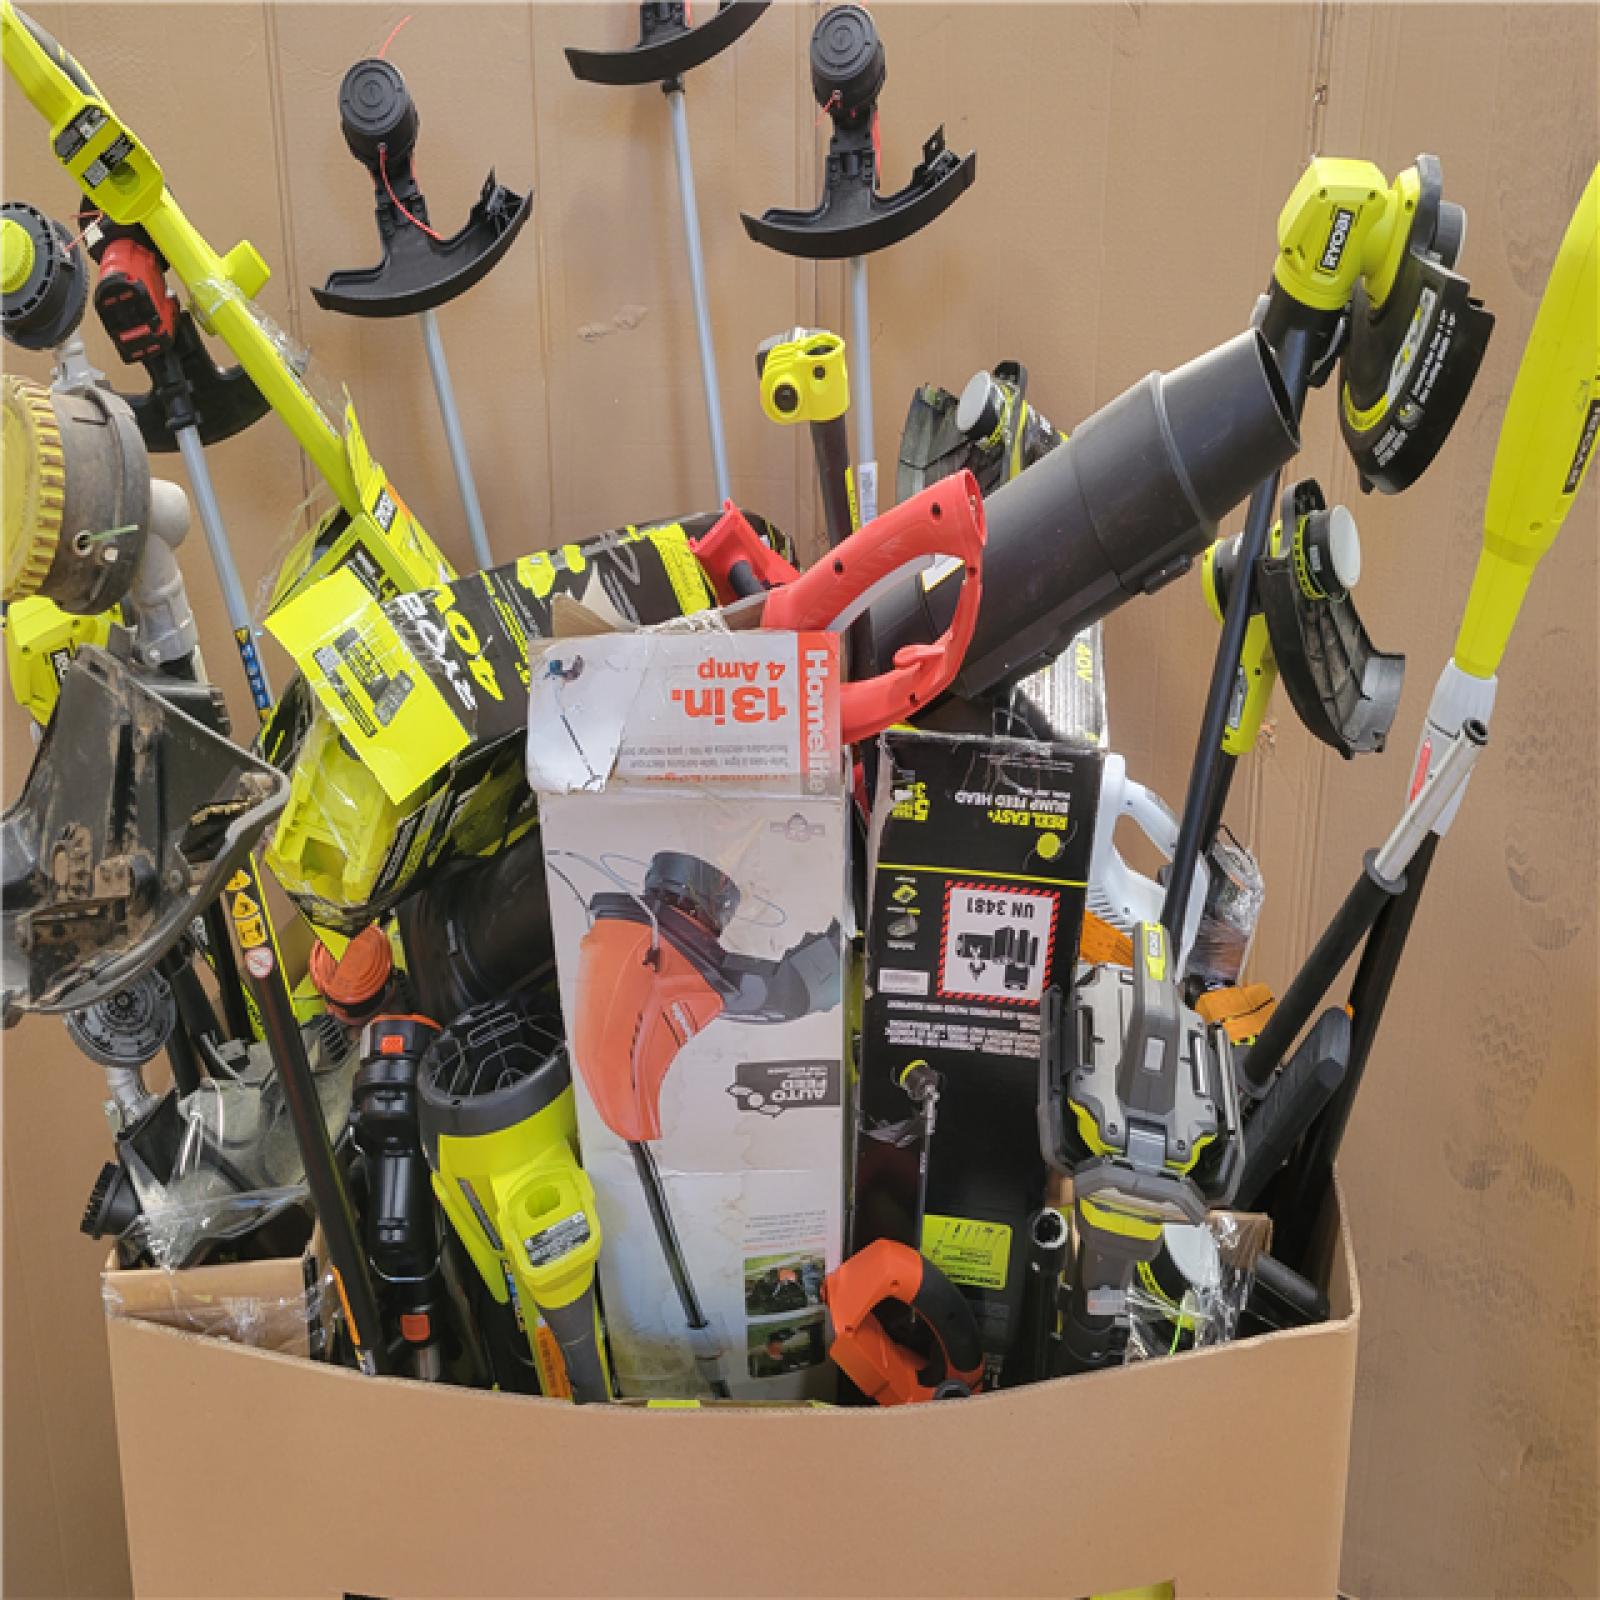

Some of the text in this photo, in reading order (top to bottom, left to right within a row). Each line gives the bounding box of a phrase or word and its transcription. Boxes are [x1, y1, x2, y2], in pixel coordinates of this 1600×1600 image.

[1322, 211, 1351, 267] RYOBI
[395, 592, 479, 712] RYOB
[697, 657, 786, 682] 4 Amp
[671, 685, 788, 727] 13 in.
[806, 649, 832, 793] Homelite
[913, 799, 931, 821] 5
[966, 896, 1036, 919] UN 3481
[770, 1088, 826, 1102] AUTO
[781, 1079, 827, 1091] FEED
